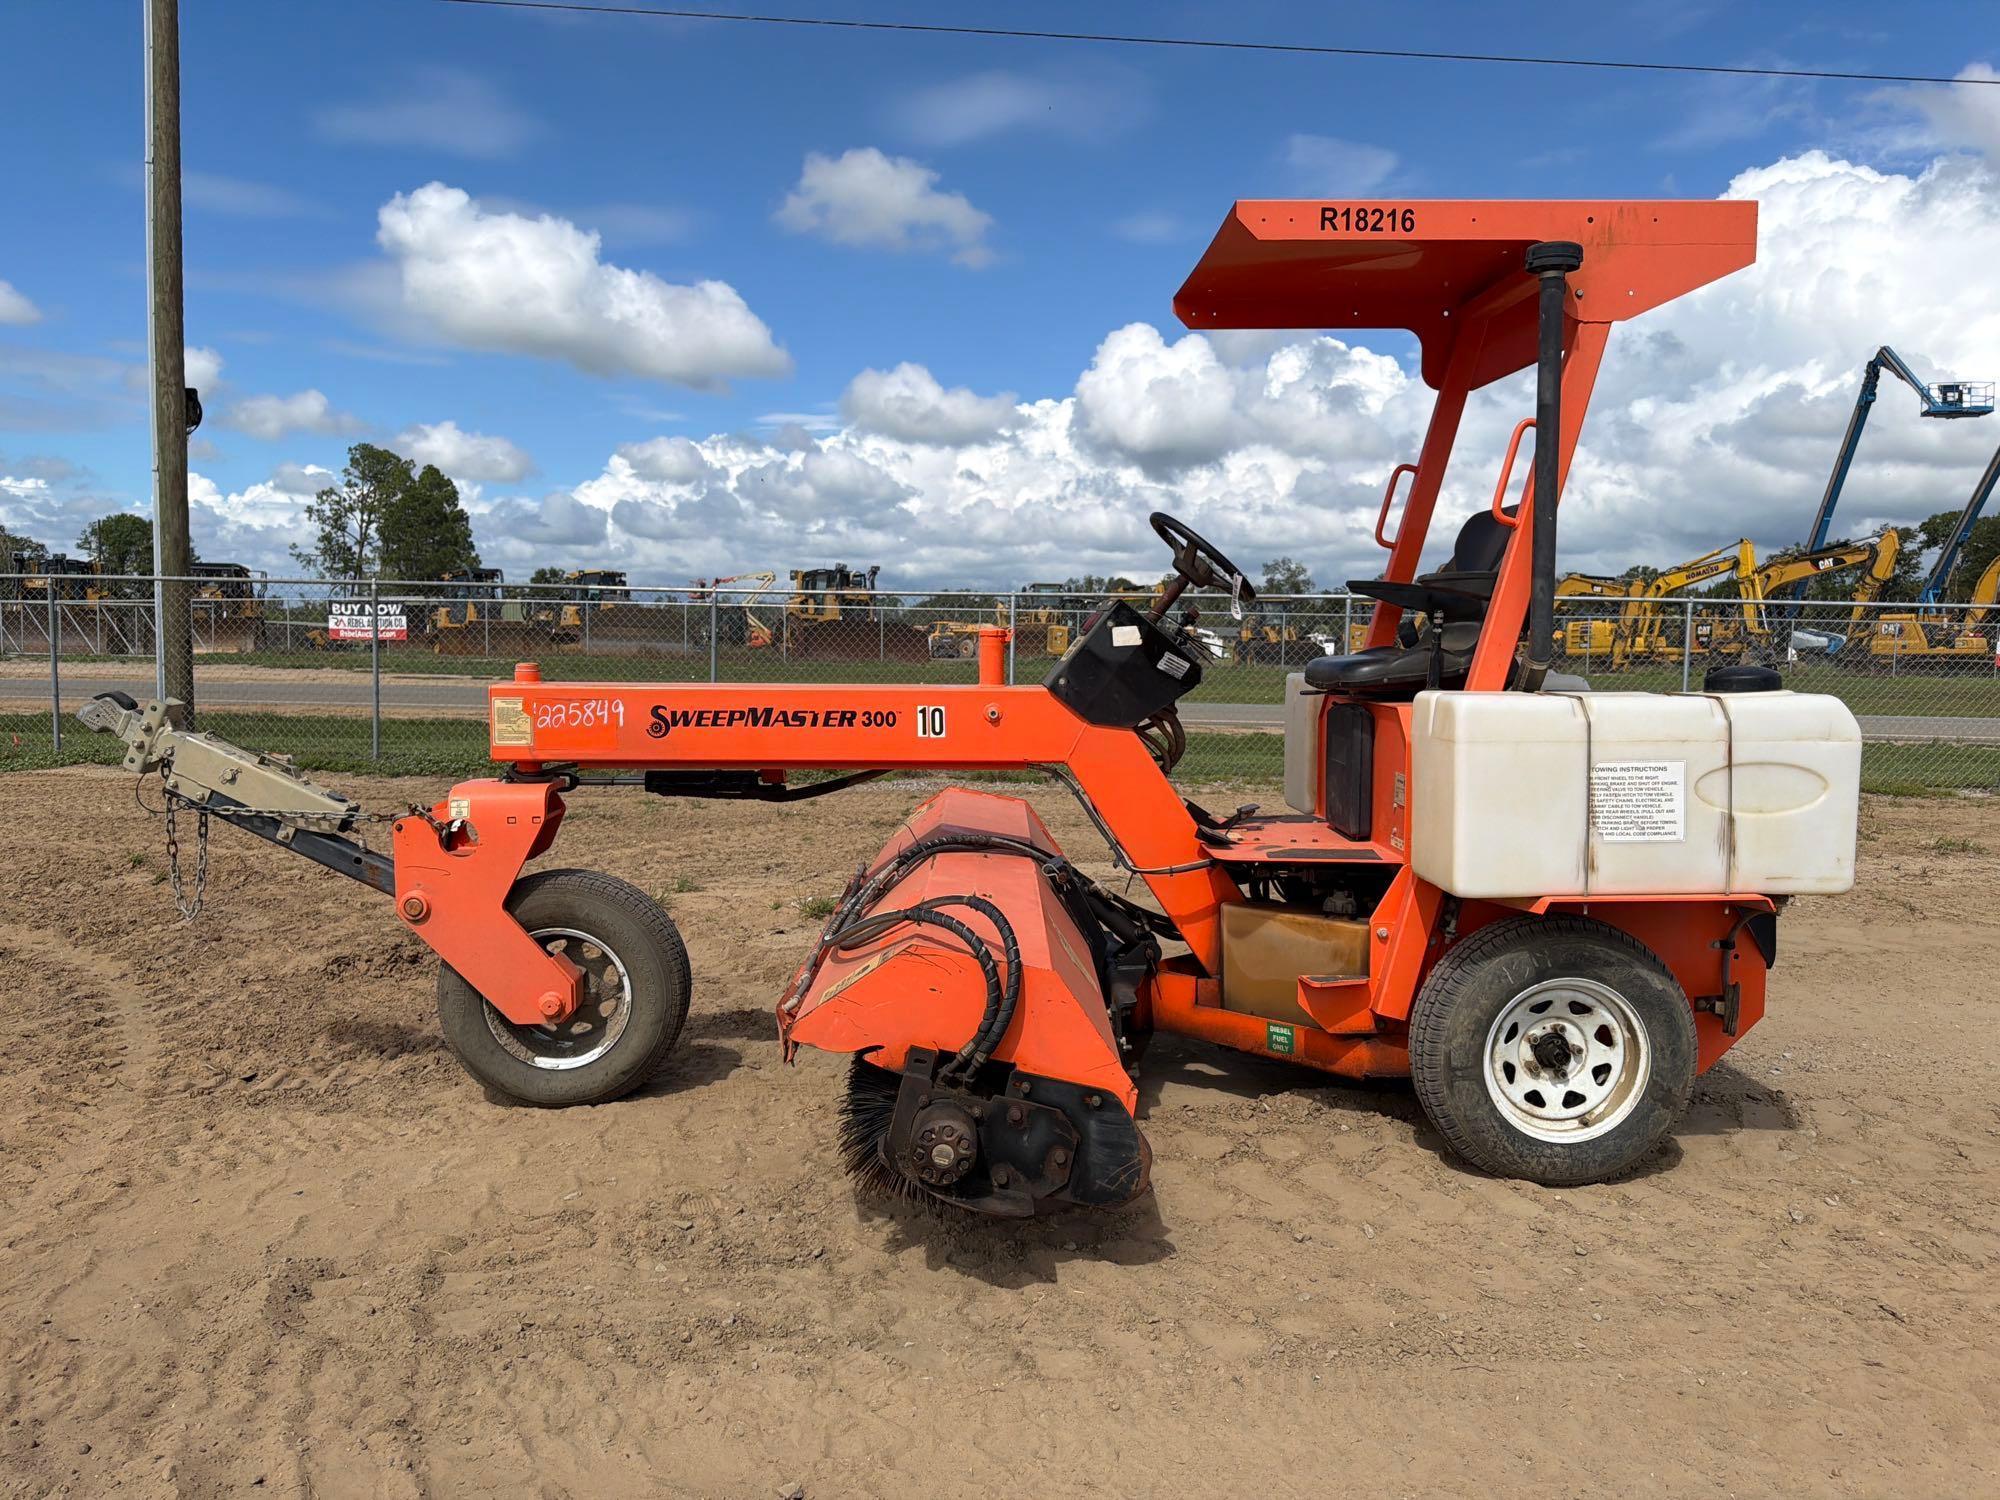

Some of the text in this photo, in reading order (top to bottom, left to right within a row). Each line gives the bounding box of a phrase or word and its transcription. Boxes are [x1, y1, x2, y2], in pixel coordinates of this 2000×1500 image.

[1320, 206, 1415, 233] R18216
[1818, 557, 1834, 570] CAT
[1685, 565, 1719, 580] KOMATSU
[331, 603, 402, 615] BUY NOW
[347, 618, 364, 628] REBEL
[366, 618, 393, 628] ATION
[1697, 625, 1711, 635] CAT
[918, 706, 945, 736] 10
[1619, 765, 1668, 773] INSTRUCTIONS
[1269, 1025, 1292, 1036] DIESEL
[1272, 1034, 1289, 1044] FUEL
[1272, 1043, 1289, 1052] ONLY
